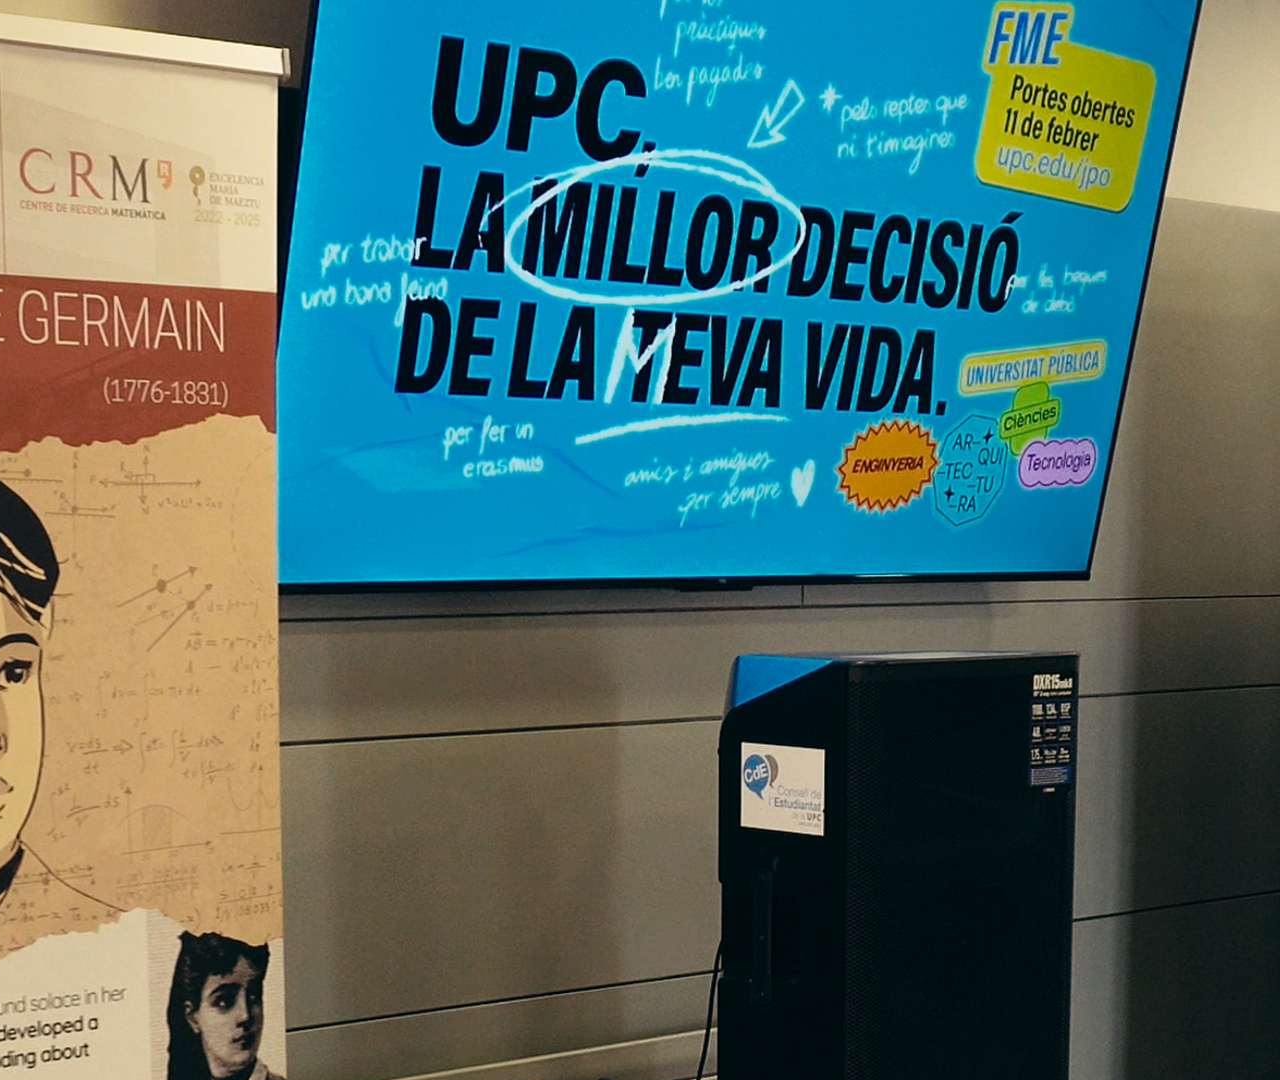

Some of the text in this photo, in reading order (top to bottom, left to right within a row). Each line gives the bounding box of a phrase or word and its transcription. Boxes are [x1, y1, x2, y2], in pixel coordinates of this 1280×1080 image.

[988, 10, 1069, 65] FME
[686, 52, 765, 106] pagades
[884, 91, 931, 123] reptes
[935, 94, 970, 126] que
[1010, 74, 1136, 129] Portes obertes
[1004, 107, 1099, 152] 11 de febrer
[19, 147, 152, 204] CRM
[209, 172, 265, 187] EXCELENCIA
[997, 147, 1111, 190] upc.edu/jpo
[20, 200, 53, 211] CENTRE
[56, 202, 68, 213] DE
[70, 203, 109, 216] RECERCA
[194, 209, 260, 227] 2022 2025
[410, 164, 1024, 313] LA MILLOR DECISIÓ
[345, 277, 391, 305] bona
[20, 287, 226, 354] GERMAIN
[394, 297, 501, 397] DE
[507, 301, 595, 402] LA
[805, 321, 947, 416] VIDA.
[966, 350, 1100, 386] UNIVERSITAT PÚBLICA
[102, 376, 229, 409] (1776-1831)
[1004, 406, 1057, 430] Ciències
[443, 426, 473, 461] per
[515, 422, 534, 440] un
[977, 448, 1004, 465] QUI
[463, 456, 544, 478] erasmus
[852, 456, 924, 474] ENGINYERIA
[1027, 452, 1091, 474] Tecnologia
[719, 481, 782, 519] sempre
[744, 763, 768, 783] CdE
[777, 784, 809, 798] Consell
[40, 1043, 90, 1063] about
